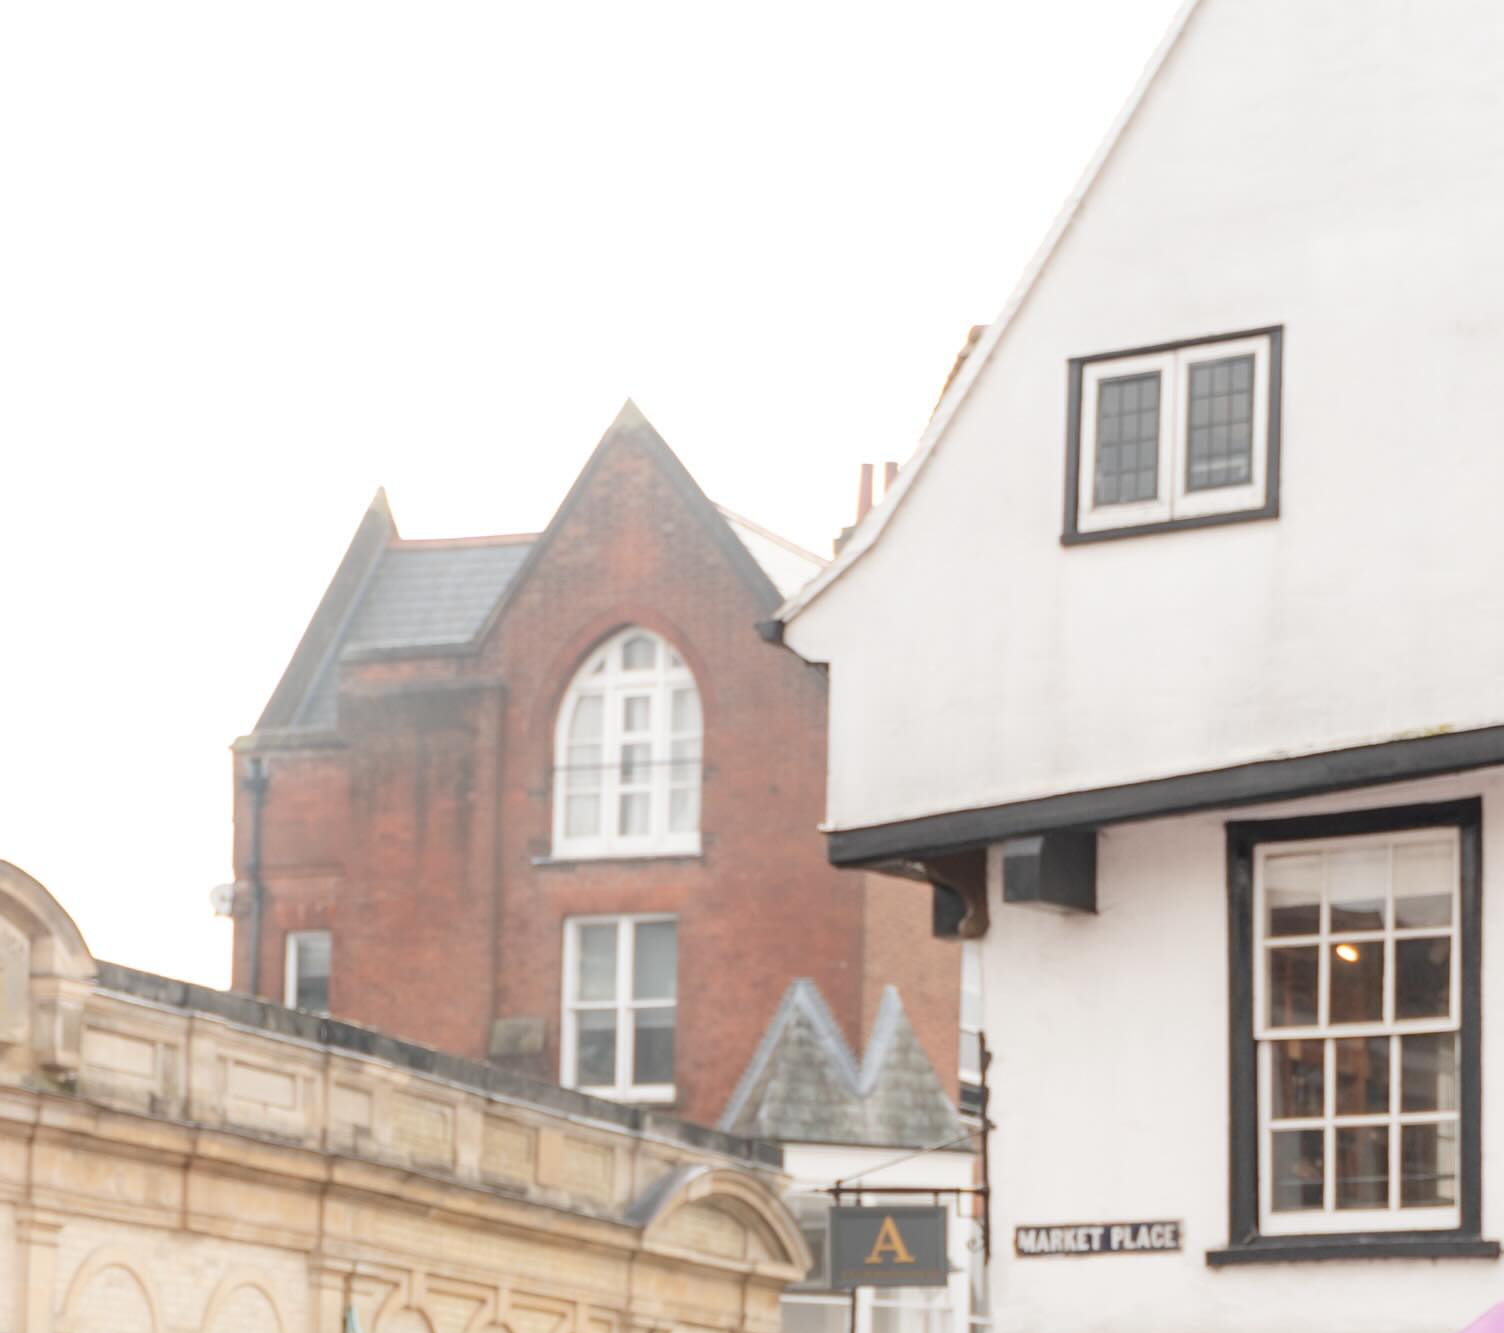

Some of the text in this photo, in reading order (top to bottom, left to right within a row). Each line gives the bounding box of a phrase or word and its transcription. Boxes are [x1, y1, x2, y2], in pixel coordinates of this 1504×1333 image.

[863, 1215, 917, 1264] A
[1018, 1223, 1178, 1253] MARKET PLACE
